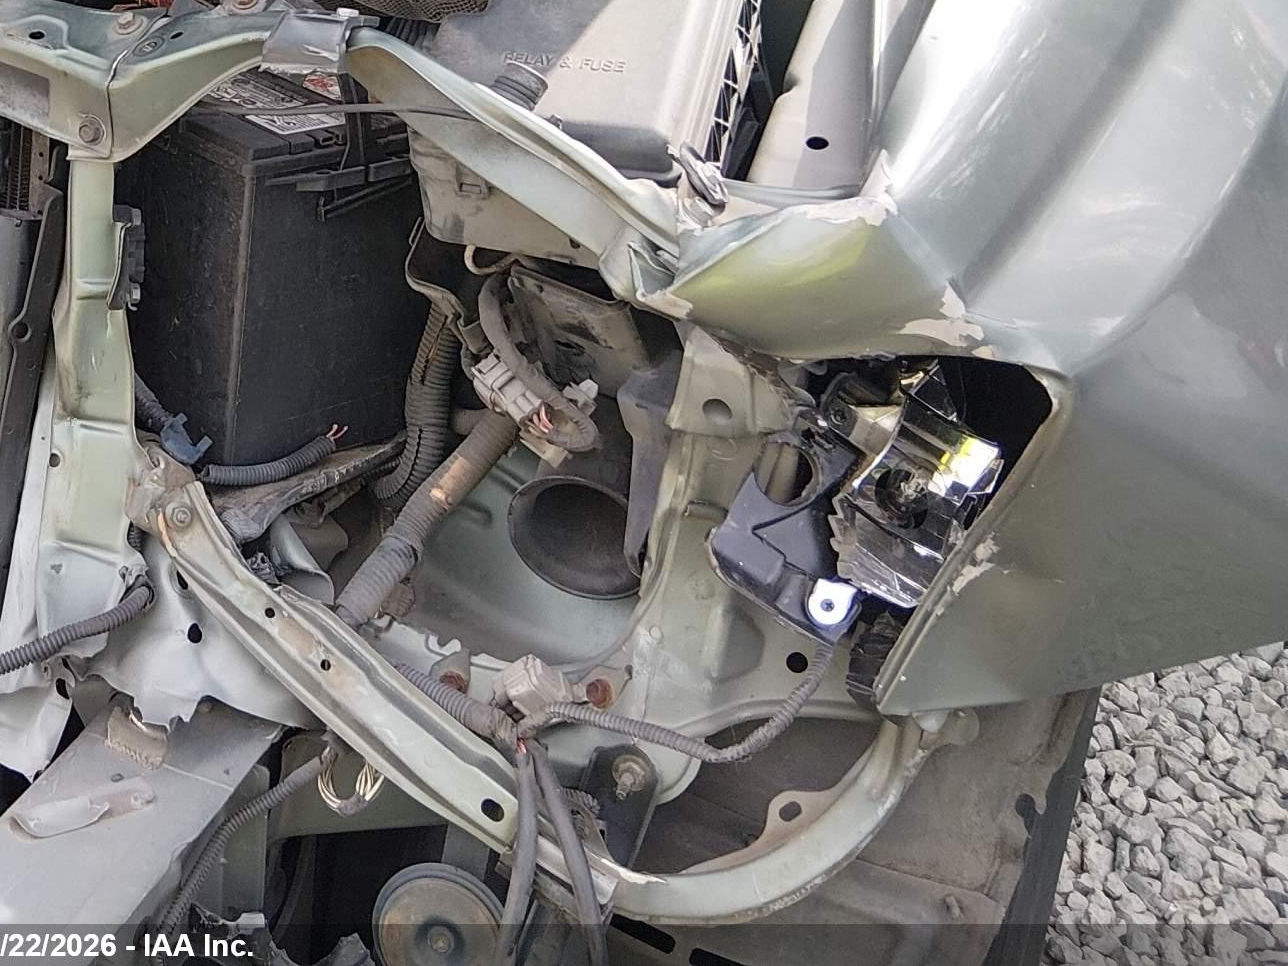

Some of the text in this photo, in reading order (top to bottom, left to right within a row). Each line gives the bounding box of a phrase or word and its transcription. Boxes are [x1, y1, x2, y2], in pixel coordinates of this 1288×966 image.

[503, 51, 626, 73] RELAY & FUSE
